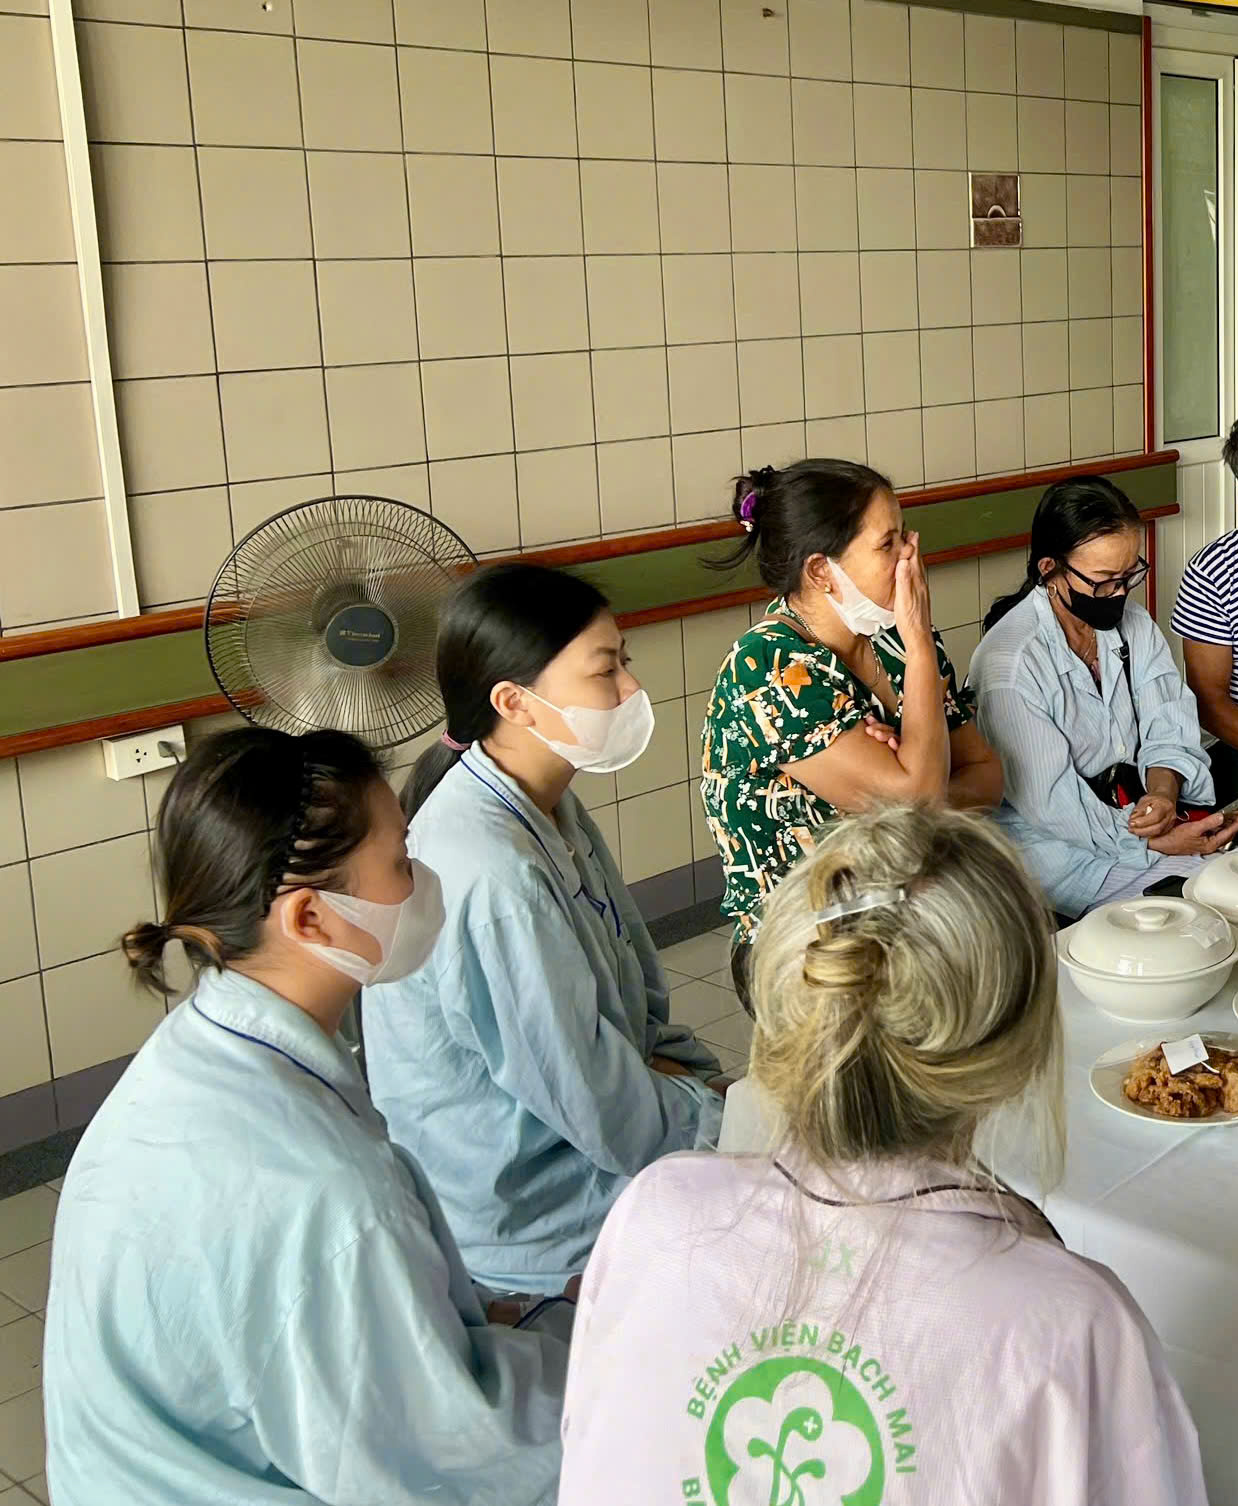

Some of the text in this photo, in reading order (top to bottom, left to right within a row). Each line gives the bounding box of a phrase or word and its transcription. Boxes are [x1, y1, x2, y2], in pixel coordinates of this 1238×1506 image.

[687, 1342, 743, 1420] BỆNH
[751, 1318, 819, 1352] VIỆN
[886, 1407, 917, 1473] MAI
